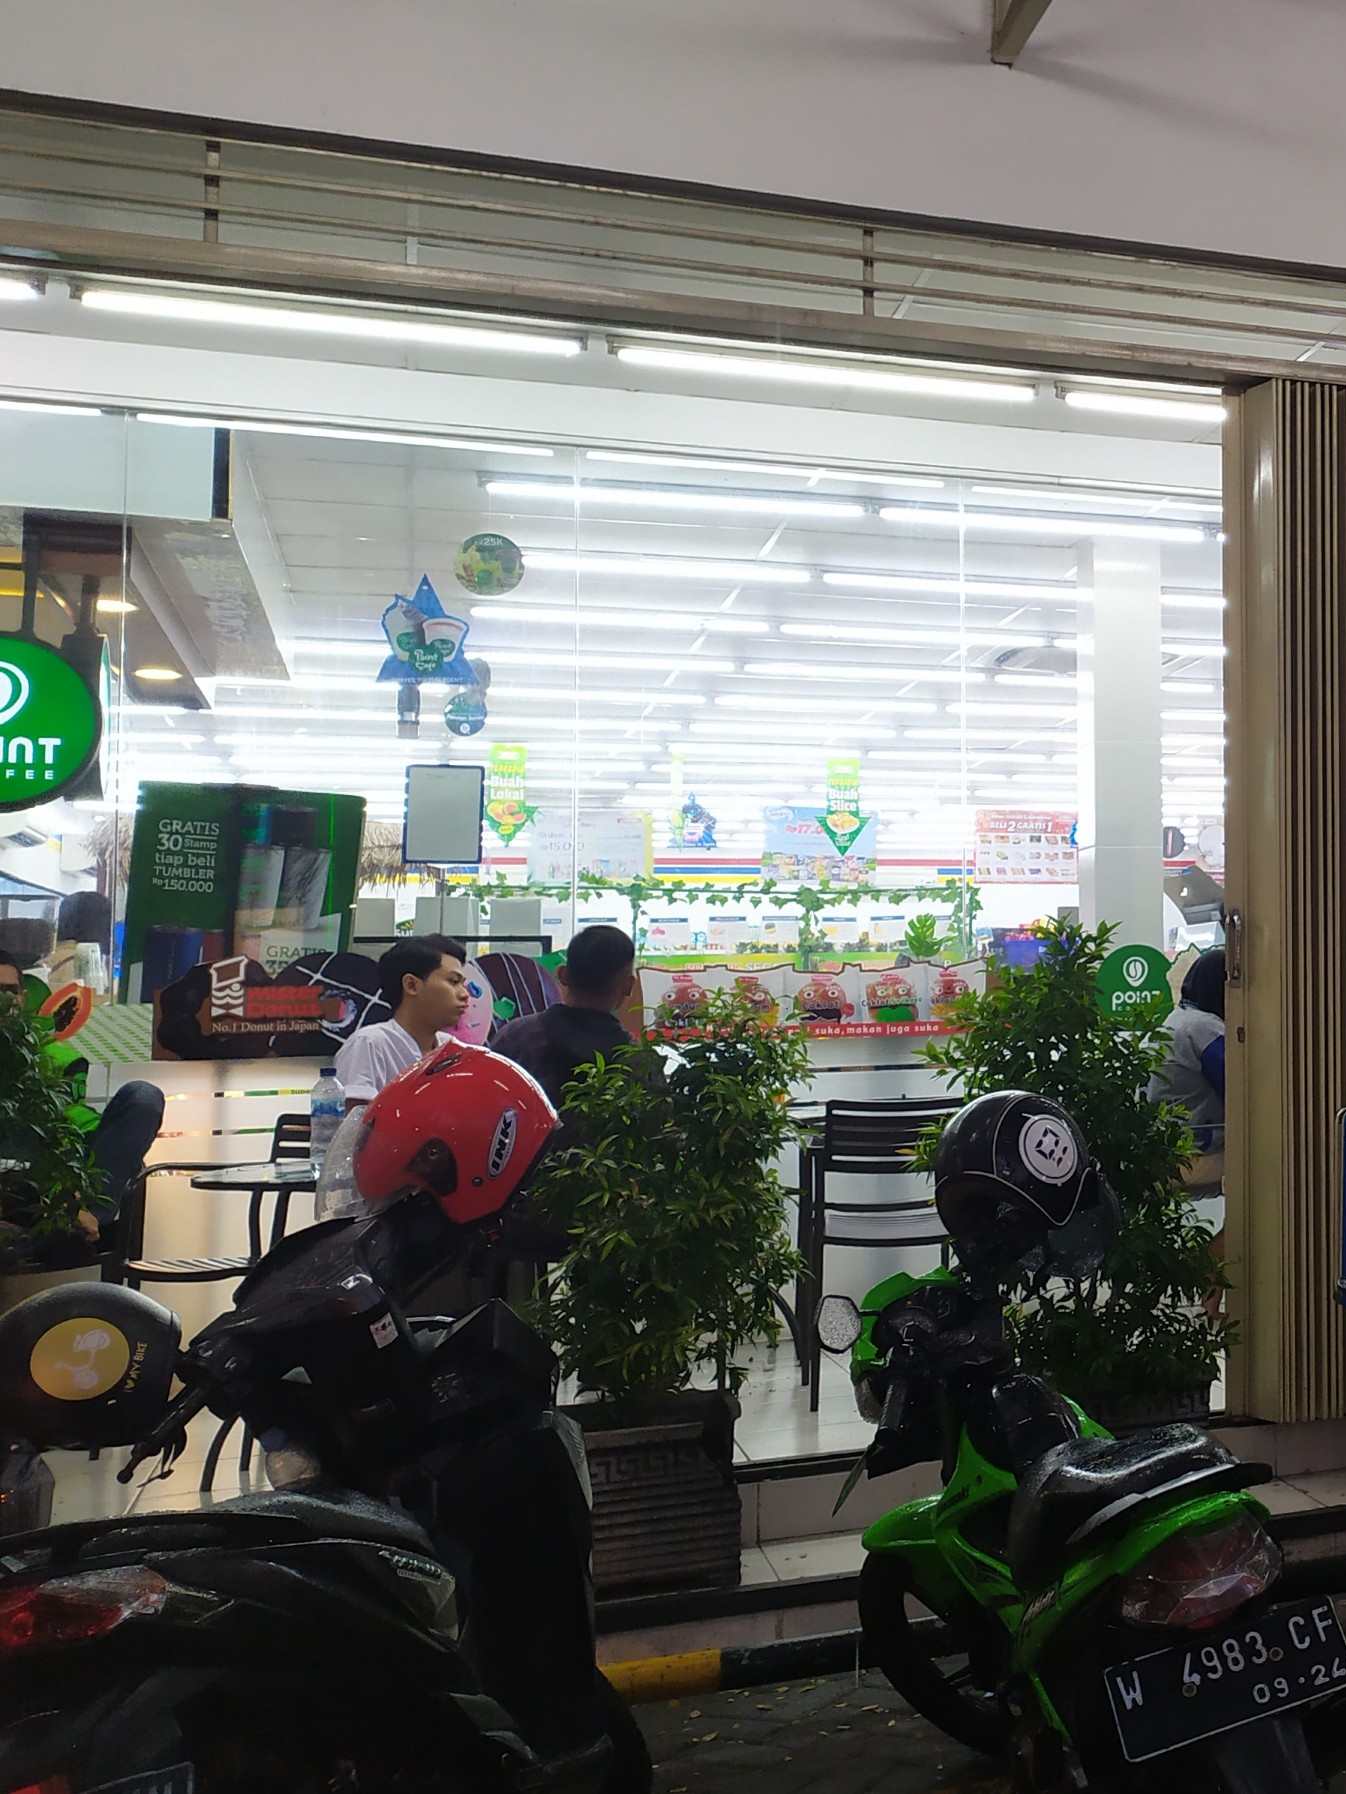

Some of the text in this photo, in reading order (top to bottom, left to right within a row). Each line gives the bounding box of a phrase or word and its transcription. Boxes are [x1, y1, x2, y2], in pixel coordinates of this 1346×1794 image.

[414, 649, 439, 661] Point
[0, 736, 62, 764] INT
[6, 769, 54, 780] FEE
[491, 775, 525, 788] Buah
[490, 788, 525, 801] Lokal
[828, 789, 858, 800] Buah
[830, 800, 857, 811] Slice
[158, 819, 220, 836] GRATIS
[990, 821, 1053, 833] BELI 2 GRATIS 1
[157, 834, 217, 851] 30 Stamp
[155, 851, 215, 867] tiap beli
[154, 866, 215, 879] TUMBLER
[802, 1001, 840, 1010] Coklat
[212, 1020, 319, 1034] No.1 Donut in Japan
[815, 1025, 845, 1036] suka,
[846, 1024, 882, 1034] makan
[886, 1023, 910, 1035] juga
[914, 1023, 939, 1033] suka
[491, 1117, 513, 1172] INK
[133, 1340, 148, 1361] BIKE
[129, 1361, 141, 1380] MY
[1116, 1604, 1334, 1711] W 4983 CF
